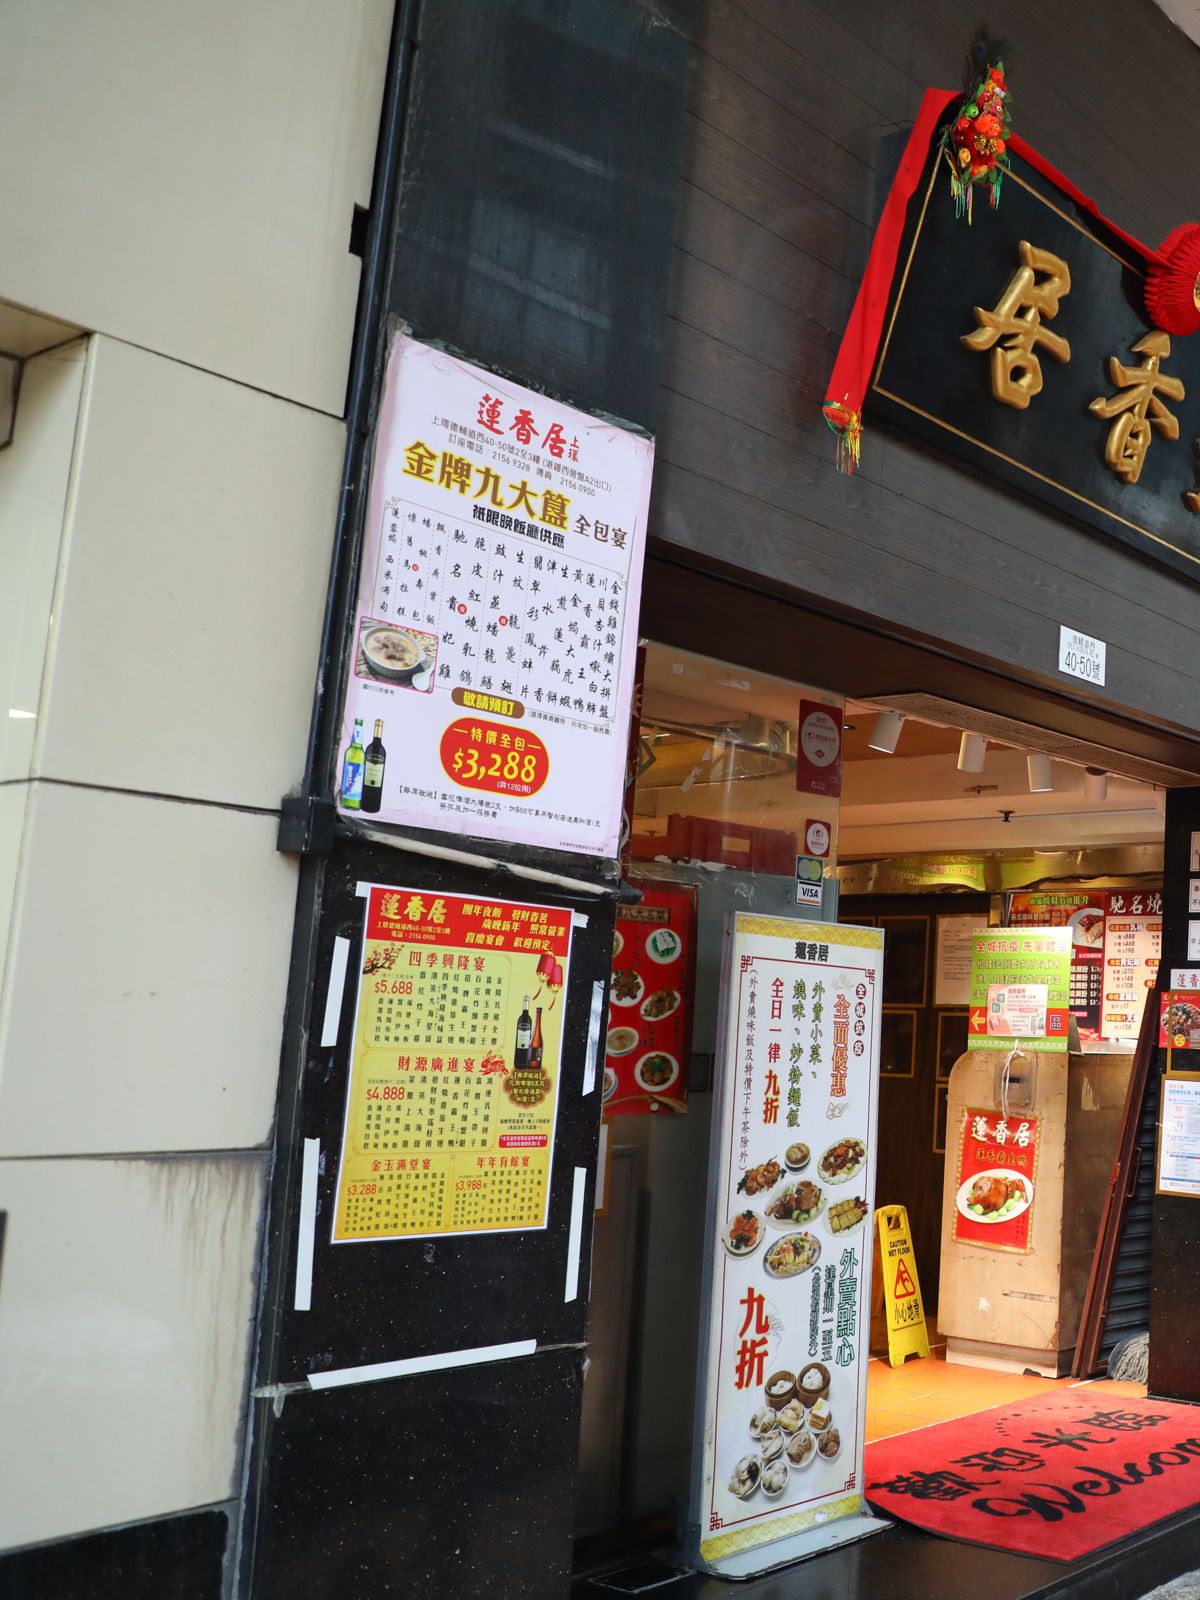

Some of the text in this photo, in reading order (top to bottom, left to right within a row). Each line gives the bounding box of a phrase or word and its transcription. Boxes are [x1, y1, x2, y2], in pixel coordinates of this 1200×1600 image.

[476, 393, 568, 459] 蓮香居
[492, 451, 511, 465] 2156
[512, 458, 531, 472] 9328
[559, 477, 577, 490] 2156
[578, 483, 596, 497] 0900
[402, 440, 628, 550] 金牌九大簋 全包宴
[463, 691, 515, 716] 敬請預訂
[471, 726, 526, 752] 特價全包
[452, 747, 537, 784] $3,288
[380, 892, 448, 924] 蓮香居
[801, 886, 819, 898] VISA
[409, 951, 485, 971] 四季興隆宴
[976, 940, 1018, 953] 全城抗疫
[853, 983, 867, 1057] 全城抗疫
[829, 994, 851, 1098] 全面優惠
[398, 1056, 475, 1072] 財源廣進宴
[762, 1069, 782, 1125] 九折
[971, 1116, 1030, 1146] 蓮香居
[888, 1245, 911, 1257] WET FLOOR
[889, 1238, 907, 1249] CAUTION
[835, 1247, 859, 1367] 外賣點心
[734, 1287, 770, 1390] 九折
